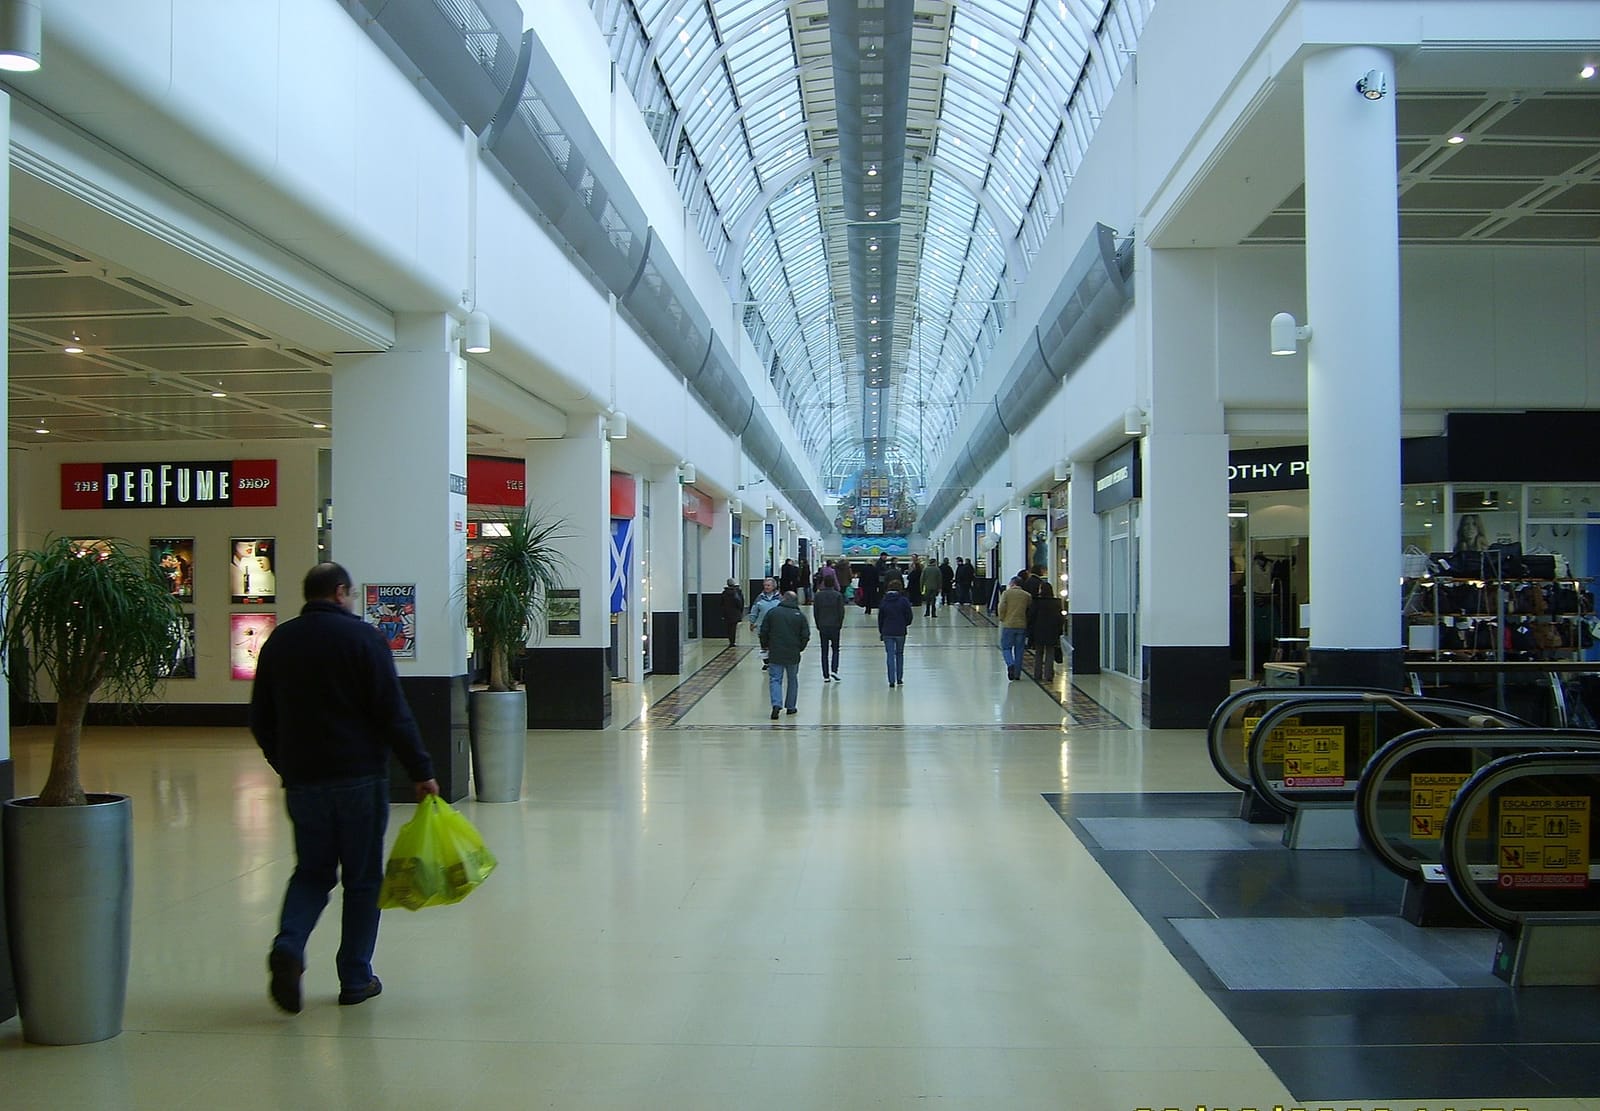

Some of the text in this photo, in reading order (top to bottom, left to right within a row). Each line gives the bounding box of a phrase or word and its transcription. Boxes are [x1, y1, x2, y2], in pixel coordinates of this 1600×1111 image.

[74, 464, 270, 505] THE PERFUME SHOP
[379, 586, 412, 597] HEROES
[1503, 800, 1586, 809] ESCALATOR SAFETY
